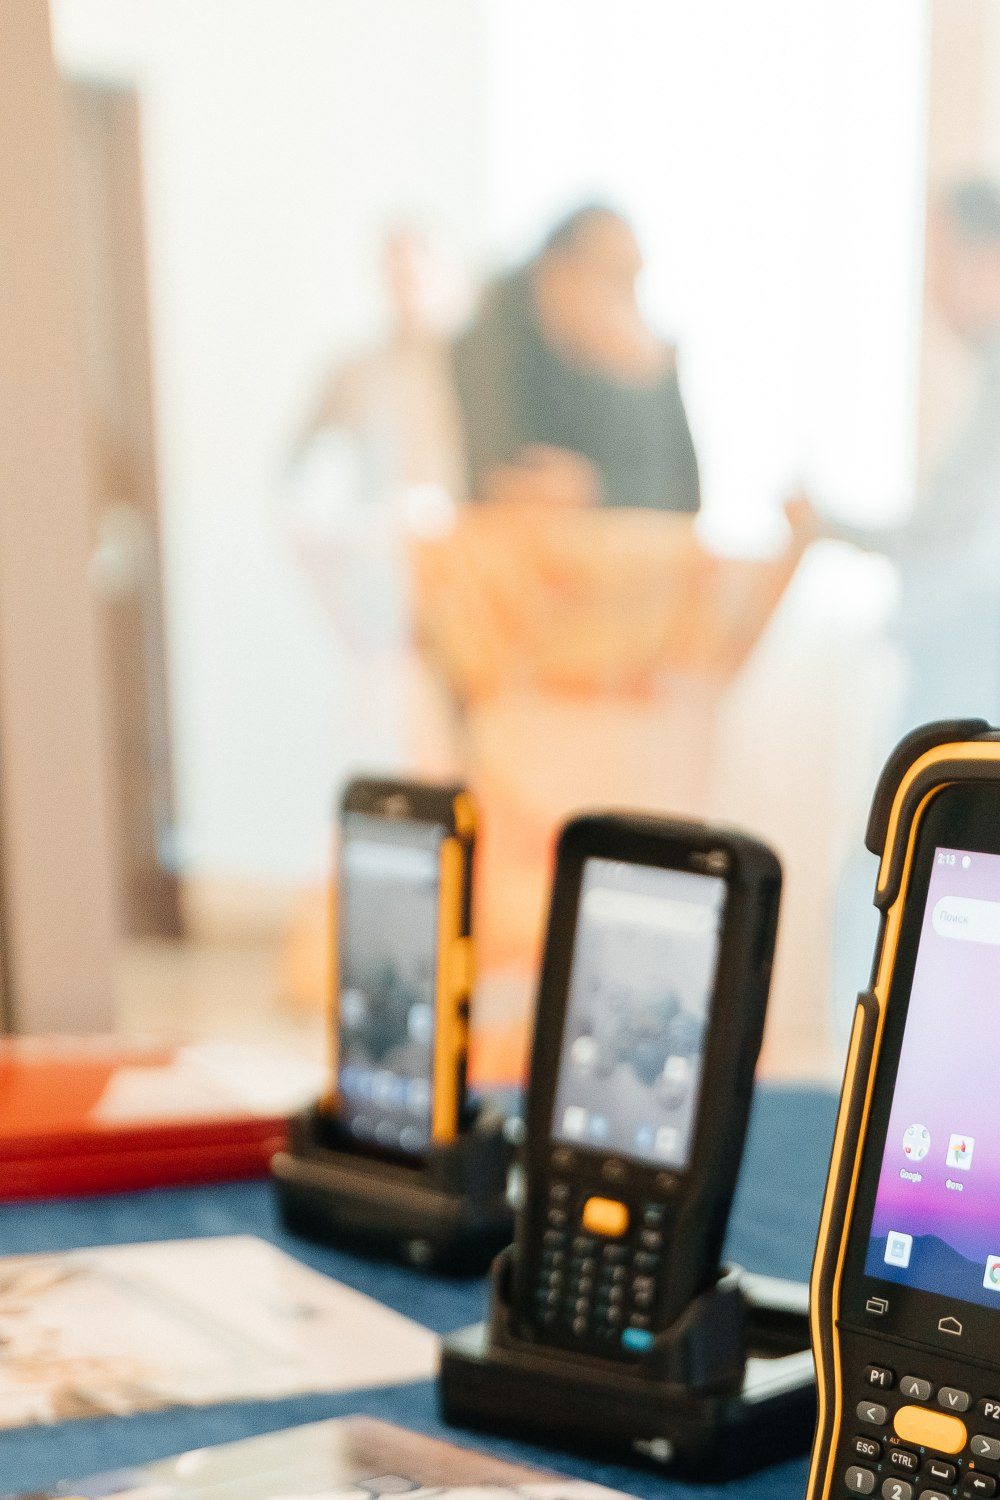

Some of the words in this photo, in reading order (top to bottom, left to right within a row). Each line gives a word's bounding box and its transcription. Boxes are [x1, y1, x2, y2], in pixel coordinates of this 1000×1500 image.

[940, 910, 968, 924] Поиск
[900, 1168, 922, 1182] Google
[946, 1179, 964, 1191] Фото
[870, 1370, 884, 1384] P1
[984, 1402, 1000, 1419] P2
[889, 1436, 900, 1444] ALT
[856, 1441, 874, 1454] ESC
[891, 1452, 913, 1468] CTRL
[856, 1472, 863, 1488] 1
[891, 1484, 902, 1500] 2
